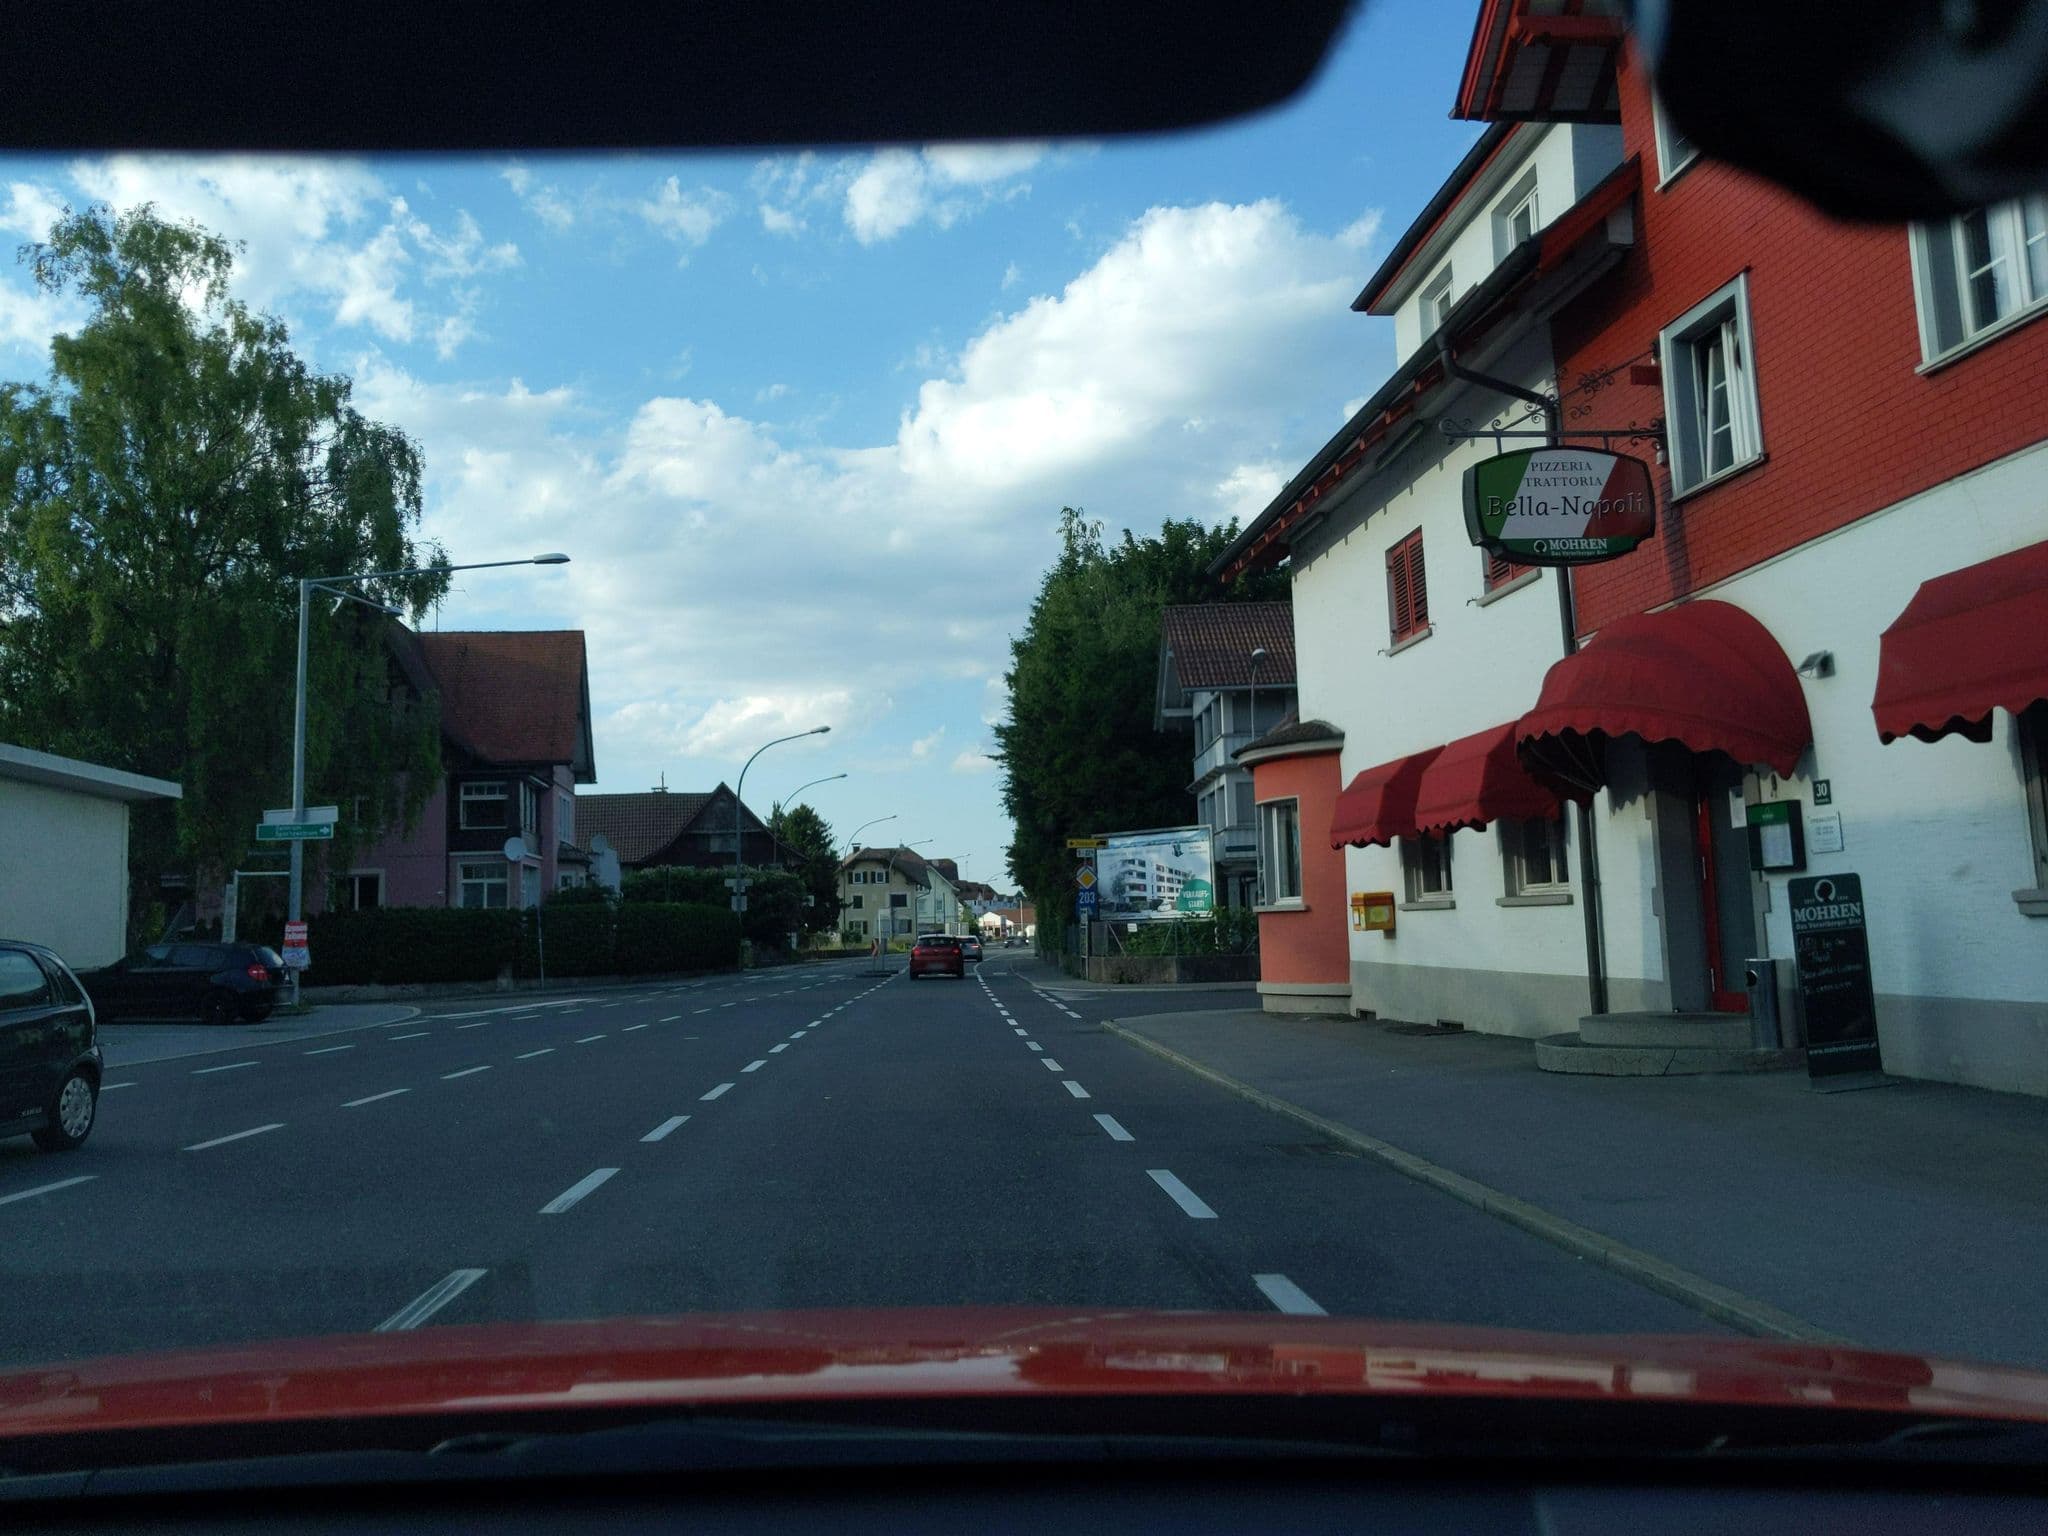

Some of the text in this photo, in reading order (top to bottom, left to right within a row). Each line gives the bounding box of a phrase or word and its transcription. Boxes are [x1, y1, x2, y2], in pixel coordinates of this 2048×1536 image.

[1531, 461, 1593, 472] PIZZERIA
[1525, 476, 1603, 488] TRATTORIA
[1487, 492, 1644, 519] Bella-Napoli
[1549, 538, 1608, 550] MOHREN
[1816, 783, 1828, 797] 30
[1079, 891, 1096, 904] 203
[1793, 902, 1861, 922] MOHREN
